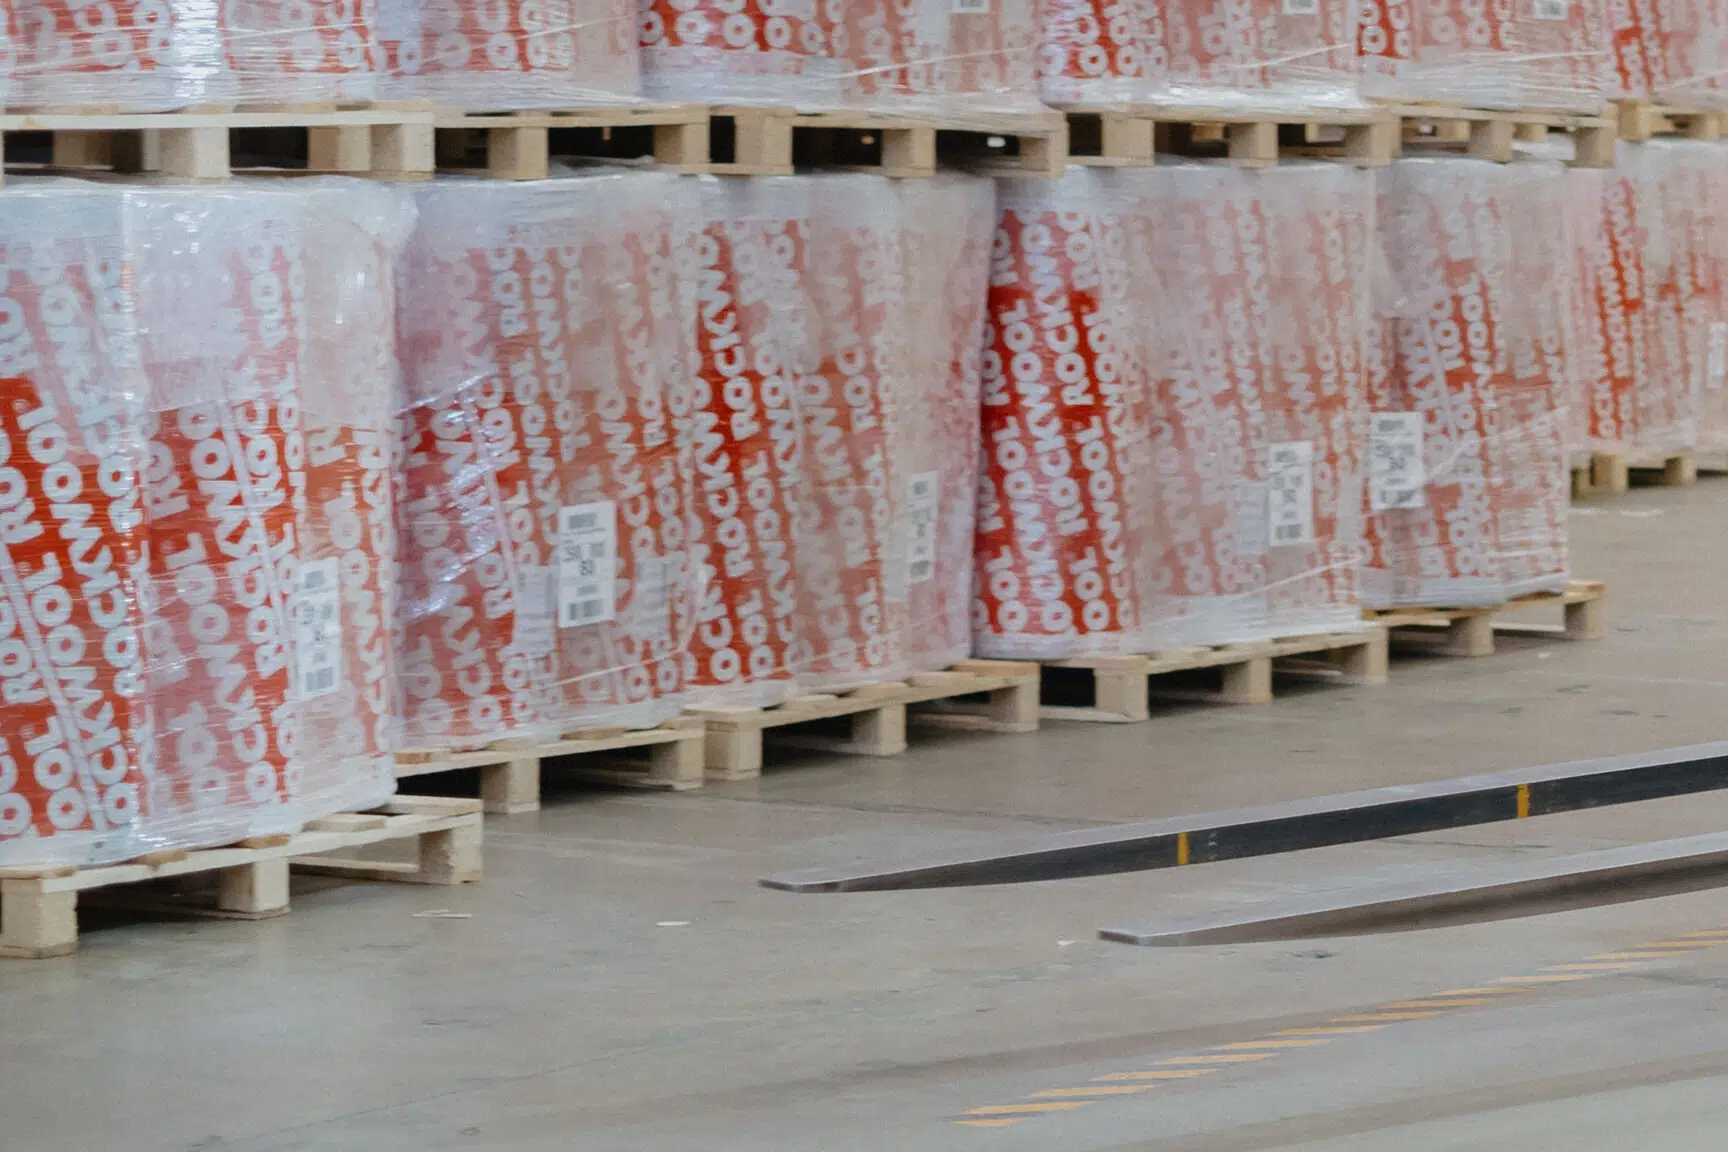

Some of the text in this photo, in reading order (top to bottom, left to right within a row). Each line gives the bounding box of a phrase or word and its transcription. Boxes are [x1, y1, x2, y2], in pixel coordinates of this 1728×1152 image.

[1002, 299, 1088, 536] ROCKWOOL
[1018, 208, 1094, 405] ROCKWO
[404, 485, 502, 730] OCKWOOL
[995, 415, 1074, 632] OCKWOOL
[1075, 415, 1132, 629] OCKWOOL
[23, 552, 140, 824] OCKWOOL
[162, 531, 278, 803] OCKWOOL
